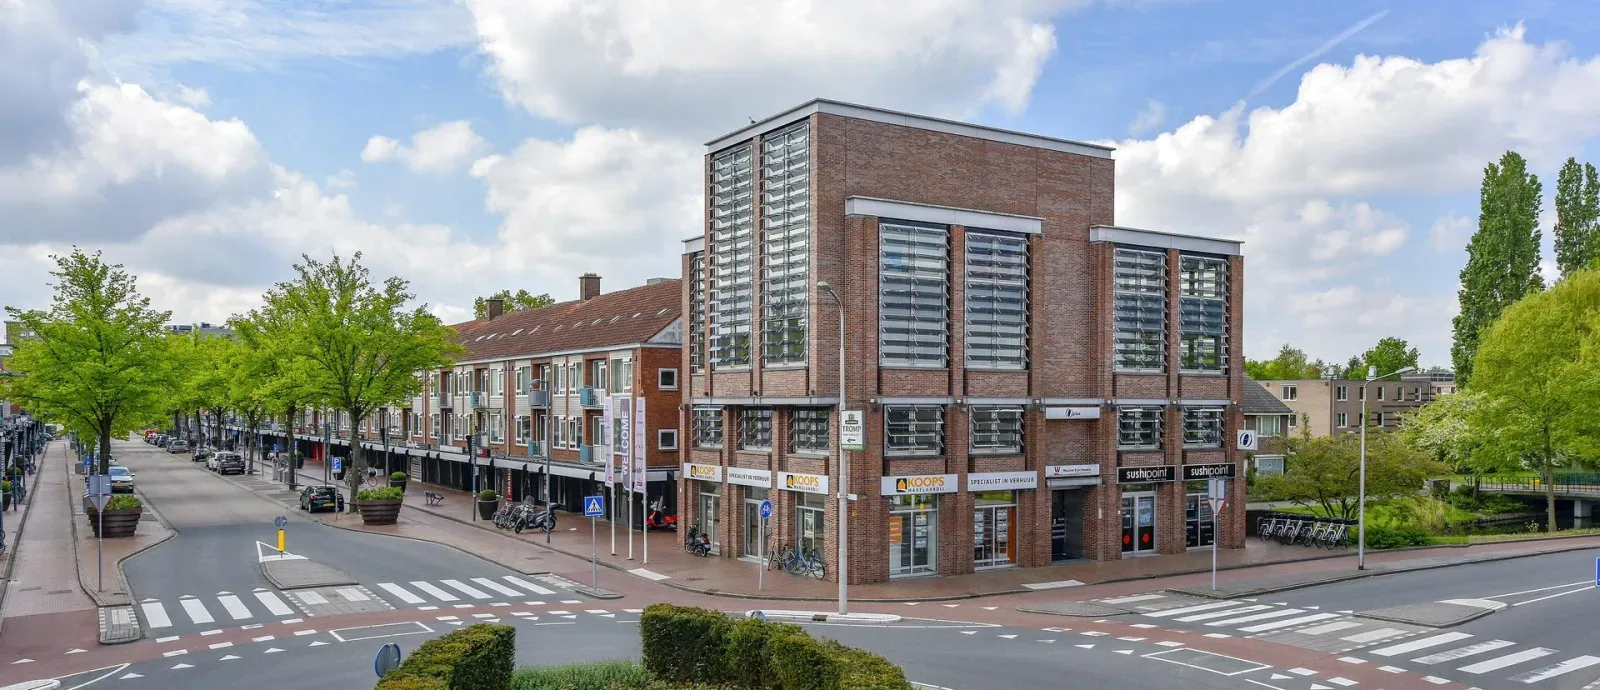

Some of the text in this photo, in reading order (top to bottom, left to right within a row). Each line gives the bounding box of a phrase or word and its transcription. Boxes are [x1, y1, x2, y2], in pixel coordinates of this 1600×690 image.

[842, 425, 862, 433] TROMP
[621, 410, 629, 476] WELCOME
[696, 466, 716, 476] KOOPS
[728, 472, 748, 480] SPECIALIST
[1126, 467, 1167, 480] sushipoint
[1190, 465, 1229, 478] sushipoint
[793, 475, 819, 487] KOOPS
[908, 476, 945, 488] KOOPS
[1009, 476, 1035, 484] VERHUUR
